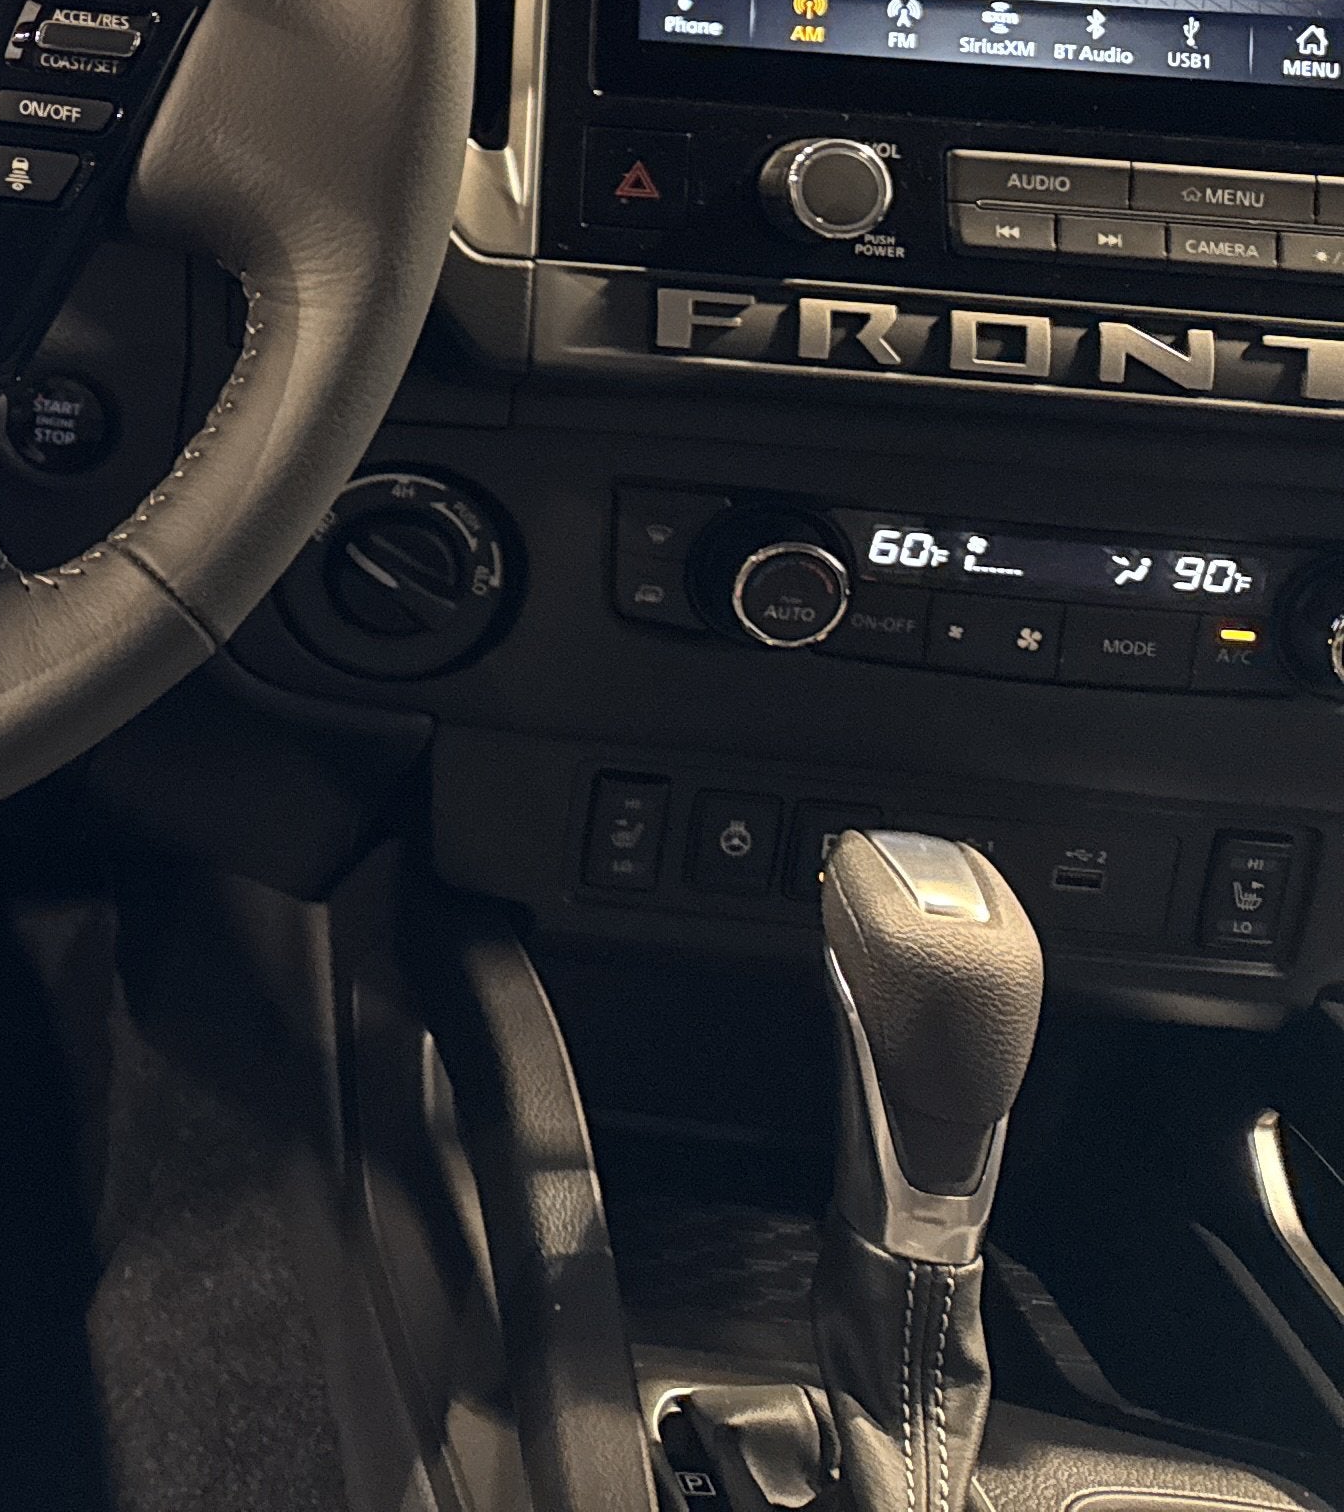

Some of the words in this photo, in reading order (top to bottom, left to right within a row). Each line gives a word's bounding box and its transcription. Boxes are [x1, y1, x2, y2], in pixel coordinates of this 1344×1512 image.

[52, 8, 131, 30] ACCEL/RES
[664, 16, 724, 37] Phone
[790, 26, 826, 43] AM
[887, 31, 917, 49] FM
[959, 37, 1036, 58] SiriusXM
[1053, 43, 1077, 60] BT
[1078, 45, 1134, 65] Audio
[40, 52, 120, 75] COAST/SET
[1167, 52, 1211, 69] USB1
[1283, 59, 1340, 79] MENU
[18, 99, 82, 123] ON/OFF
[1007, 173, 1072, 192] AUDIO
[1205, 187, 1265, 208] MENU
[863, 233, 896, 245] PUSH
[1185, 239, 1260, 258] CAMERA
[854, 243, 906, 259] POWER
[32, 399, 81, 416] START
[33, 427, 76, 446] STOP
[763, 604, 816, 622] AUTO
[849, 612, 916, 633] ON-OFF
[1102, 638, 1158, 658] MODE
[1216, 648, 1252, 666] A/C
[1247, 857, 1265, 871] HI
[1232, 920, 1253, 934] LO
